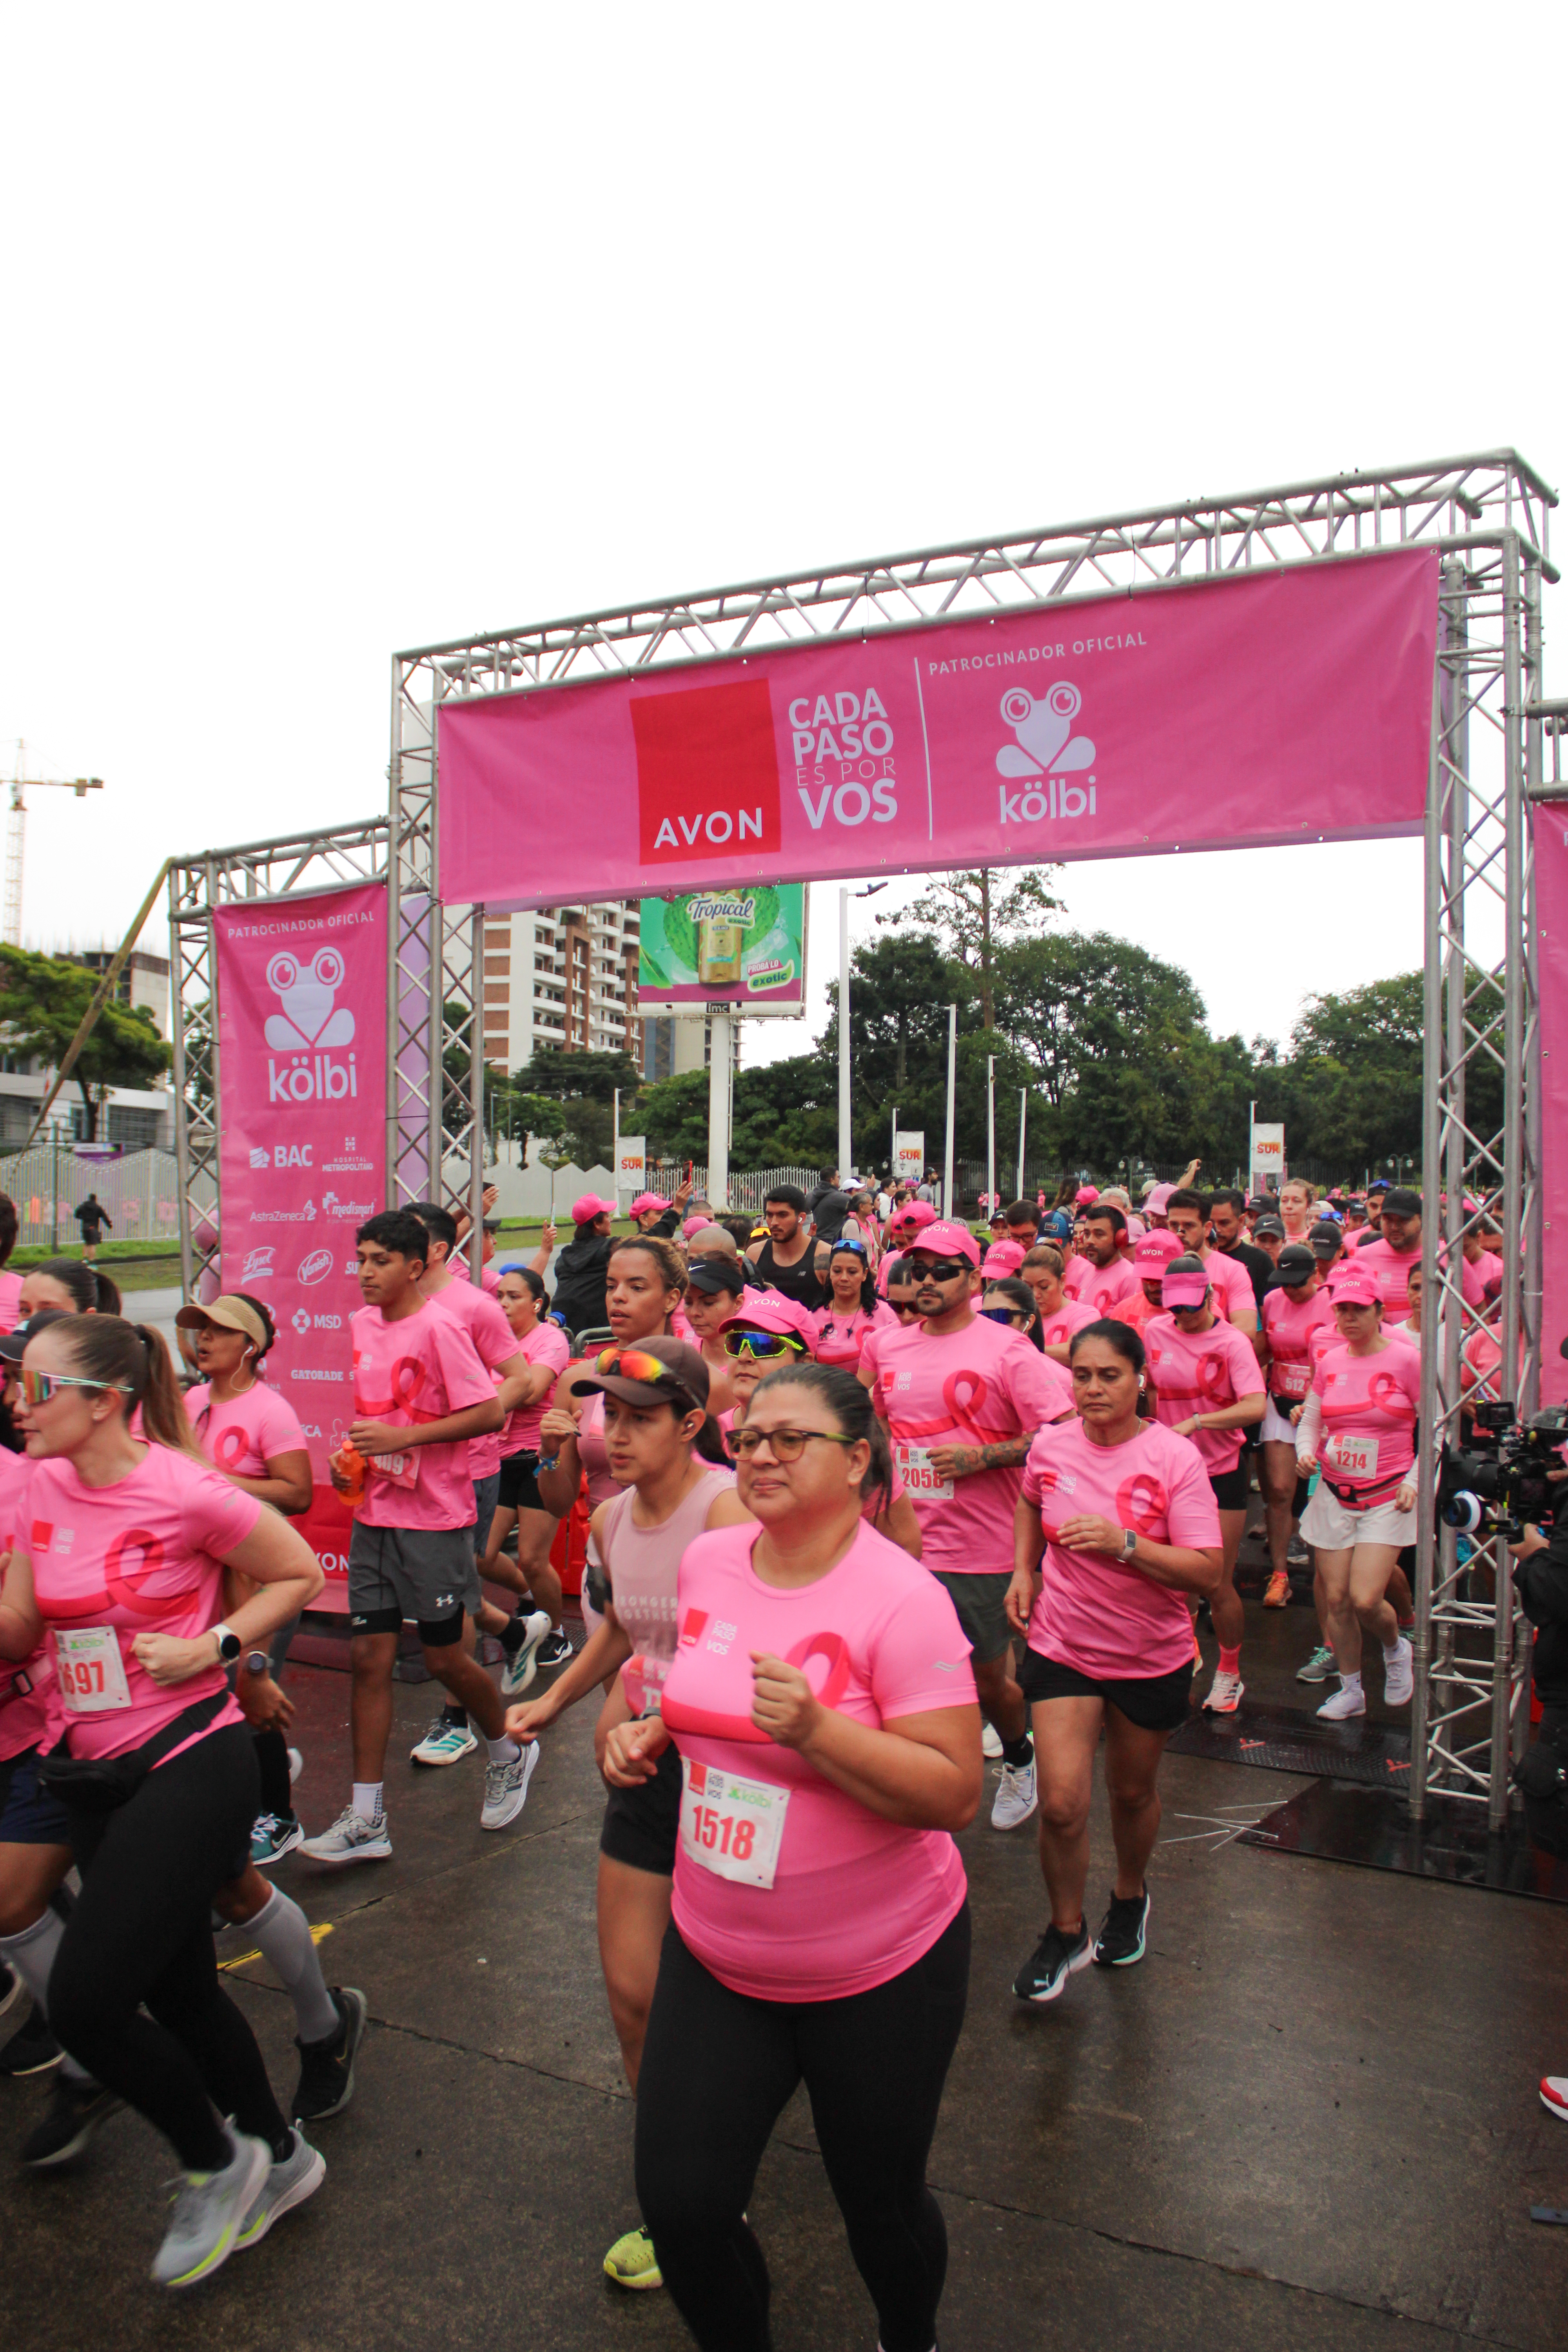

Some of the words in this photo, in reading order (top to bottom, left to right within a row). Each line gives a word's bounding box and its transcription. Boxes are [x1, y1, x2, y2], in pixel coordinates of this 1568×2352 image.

[929, 643, 1066, 676] PATROCINADOR
[1073, 632, 1147, 653] OFICIAL
[788, 687, 888, 730] CADA
[792, 720, 894, 766] PASO
[796, 765, 826, 786] ES
[841, 757, 896, 780] POR
[797, 778, 898, 829] VOS
[999, 775, 1097, 824] kölbi
[653, 807, 764, 849] AVON
[689, 898, 753, 920] Tropical
[228, 918, 324, 939] PATROCINADOR
[328, 910, 374, 927] OFICIAL
[748, 959, 769, 973] PROBÁ
[770, 959, 779, 968] LO
[753, 972, 787, 986] exotic
[708, 1003, 728, 1013] imc
[268, 1052, 357, 1102] kölbi
[274, 1143, 313, 1168] BAC
[899, 1150, 920, 1160] SUR
[1257, 1144, 1279, 1154] SUR
[322, 1162, 374, 1172] METROPOLITANO
[621, 1158, 641, 1169] SUR
[250, 1210, 305, 1222] AstraZeneca
[332, 1200, 375, 1218] medismart
[922, 1225, 949, 1236] AVON
[243, 1249, 274, 1273] Lysol
[301, 1253, 329, 1281] Vanish
[1339, 1280, 1361, 1289] AVON
[746, 1298, 780, 1308] AVON
[314, 1314, 342, 1329] MSD
[290, 1369, 344, 1381] GATORADE
[1285, 1377, 1305, 1392] 512
[1336, 1450, 1367, 1469] 1214
[902, 1467, 944, 1488] 2058
[1060, 1486, 1074, 1495] VOS
[711, 1627, 736, 1641] PASO
[715, 1620, 737, 1633] CADA
[706, 1639, 730, 1655] VOS
[708, 1789, 722, 1800] VOS
[692, 1804, 756, 1861] 1518
